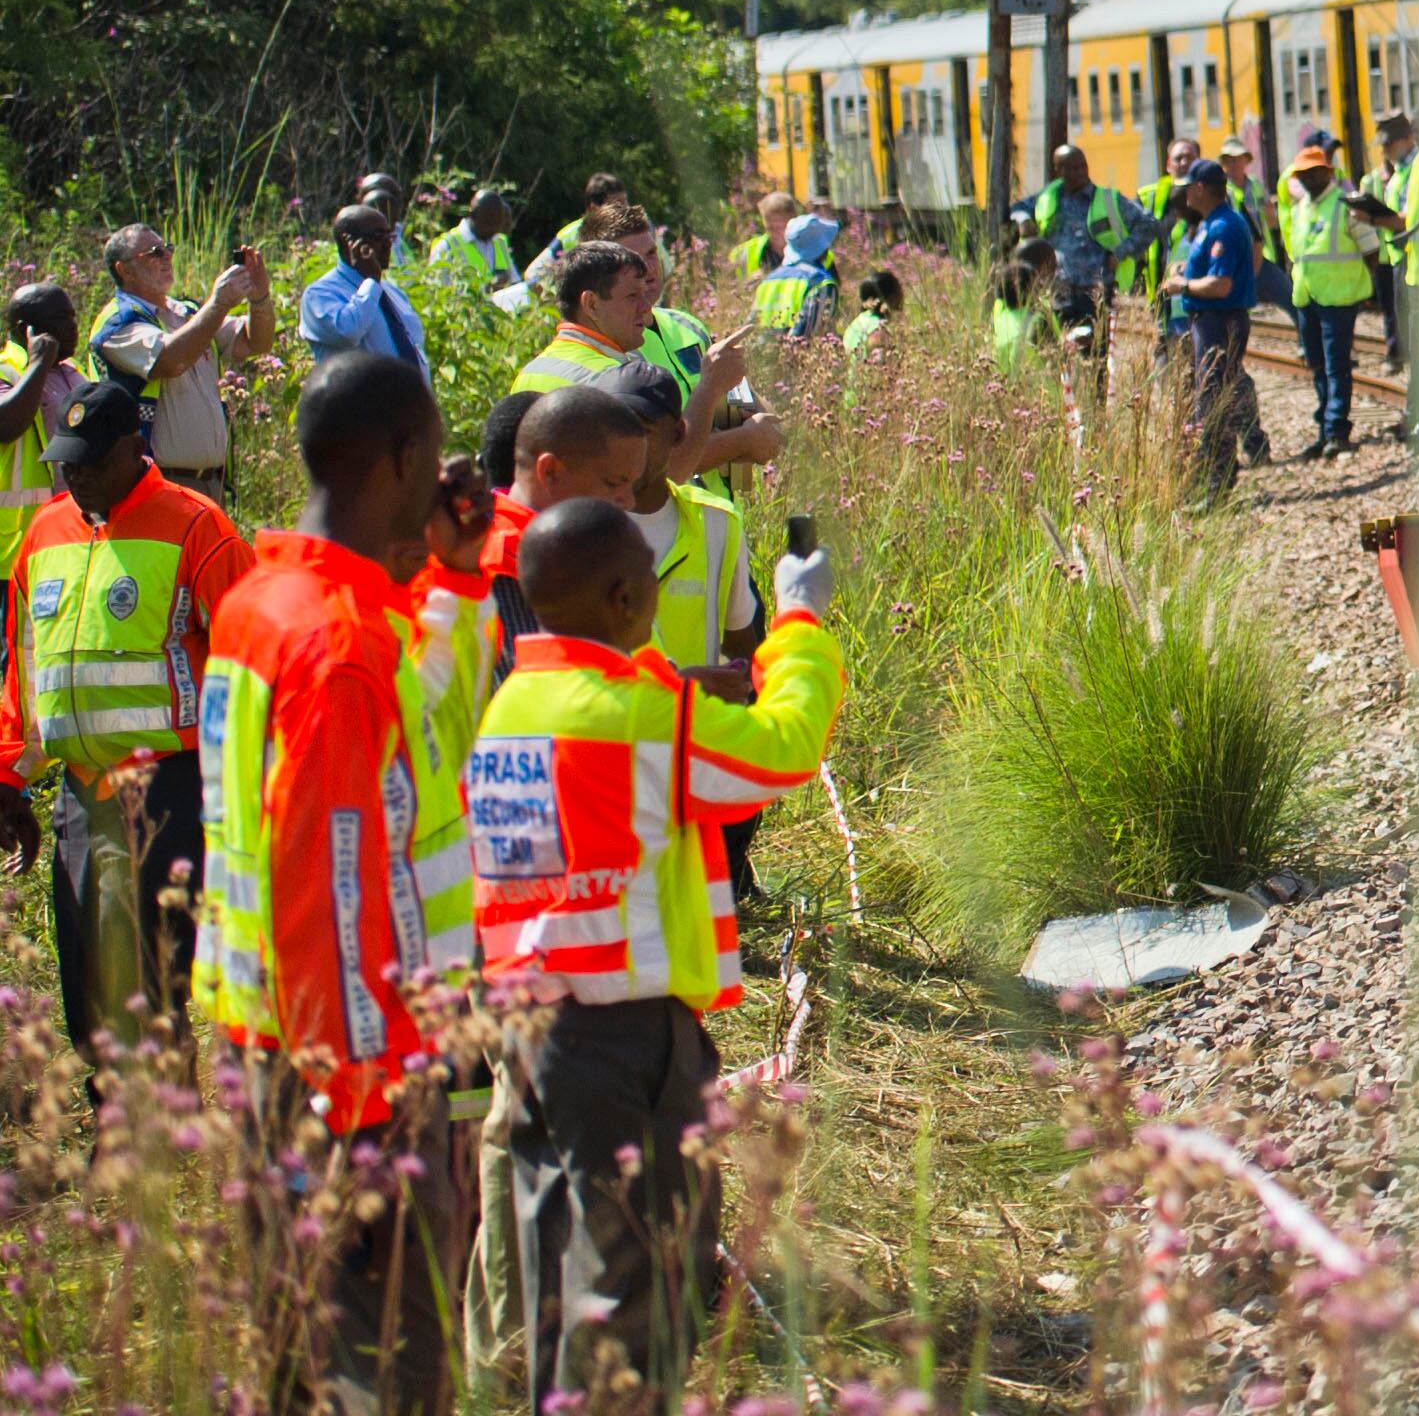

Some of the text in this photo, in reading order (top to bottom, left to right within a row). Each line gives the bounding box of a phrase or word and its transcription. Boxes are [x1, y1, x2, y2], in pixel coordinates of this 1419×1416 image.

[470, 751, 548, 784] PRASA
[472, 797, 548, 825] SECURITY
[489, 836, 534, 865] TEAM
